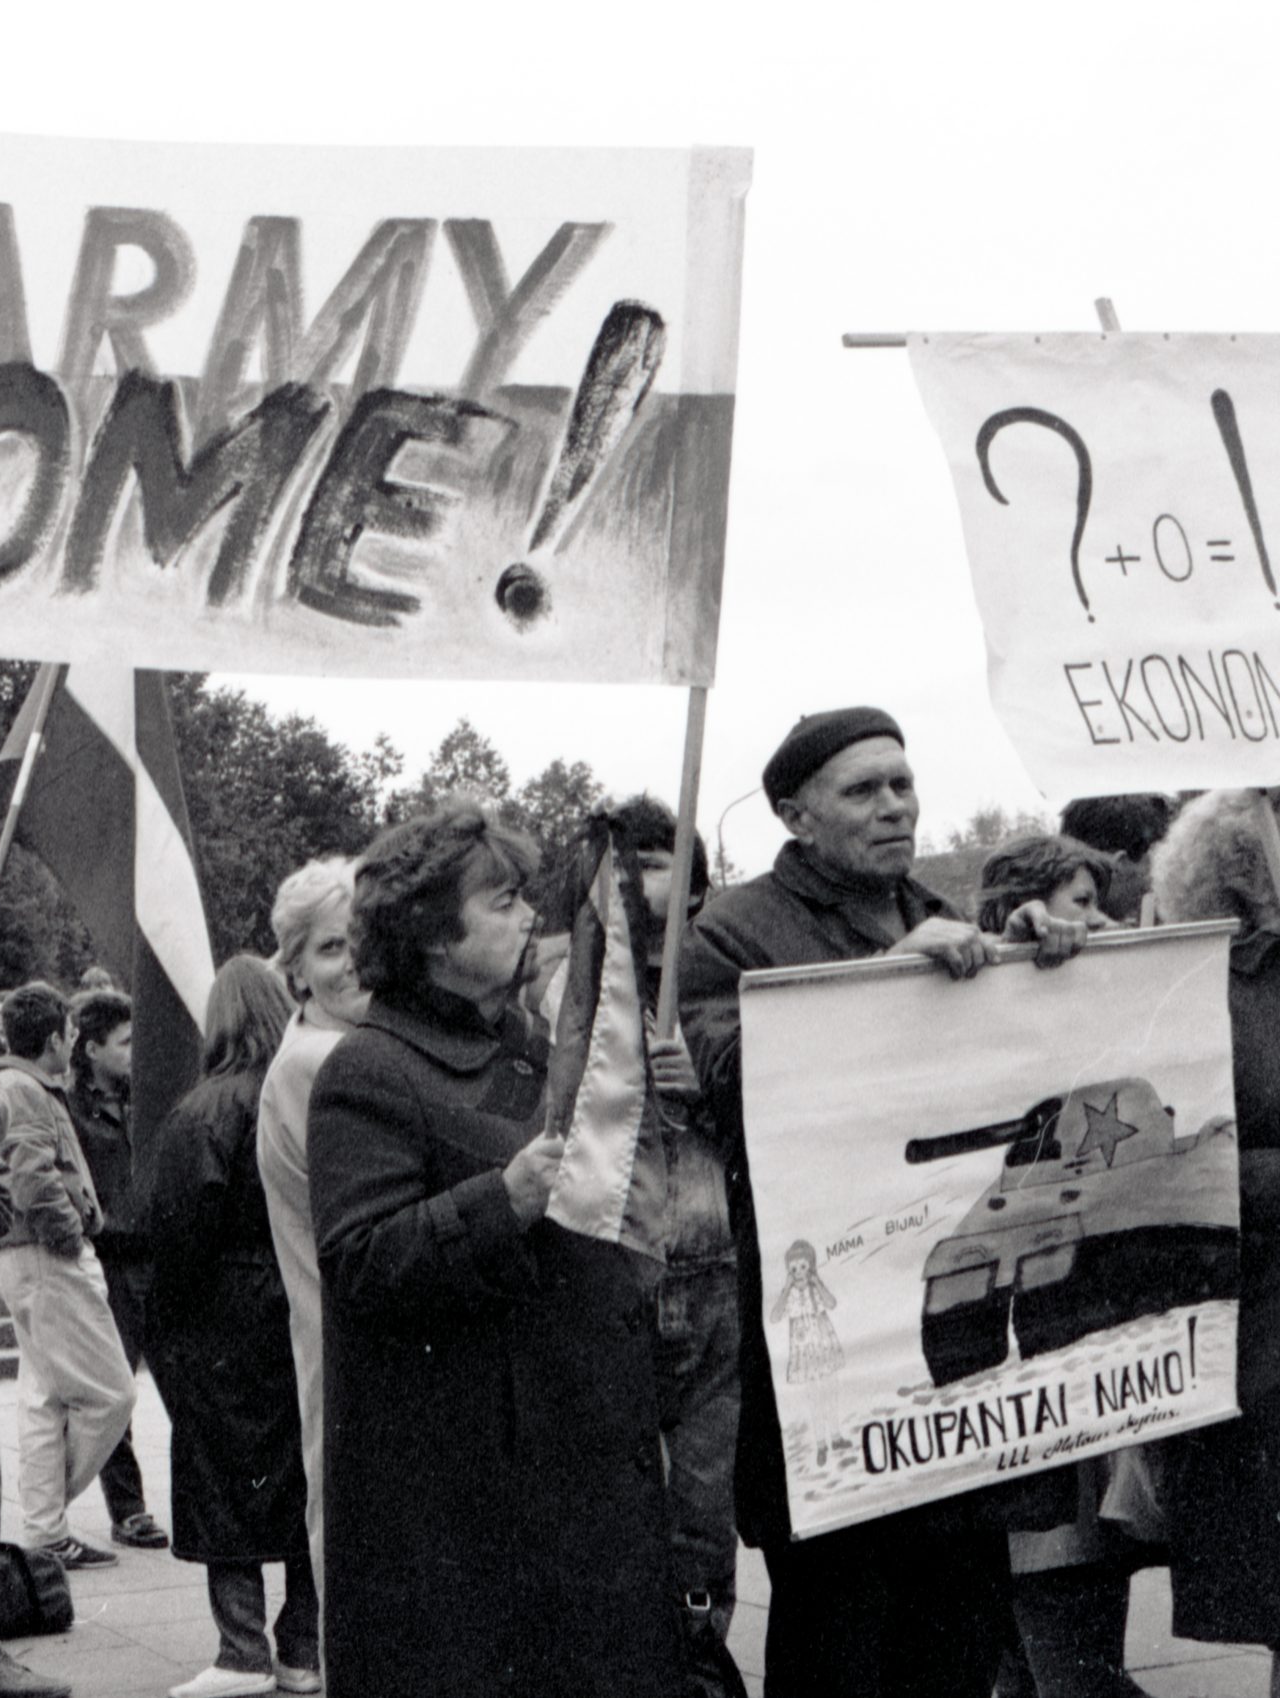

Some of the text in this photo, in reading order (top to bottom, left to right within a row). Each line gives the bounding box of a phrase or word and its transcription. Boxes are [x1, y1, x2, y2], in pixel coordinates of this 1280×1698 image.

[825, 1204, 929, 1261] MAMA BIJAU!
[860, 1315, 1198, 1475] OKUPANTAI NAMO!
